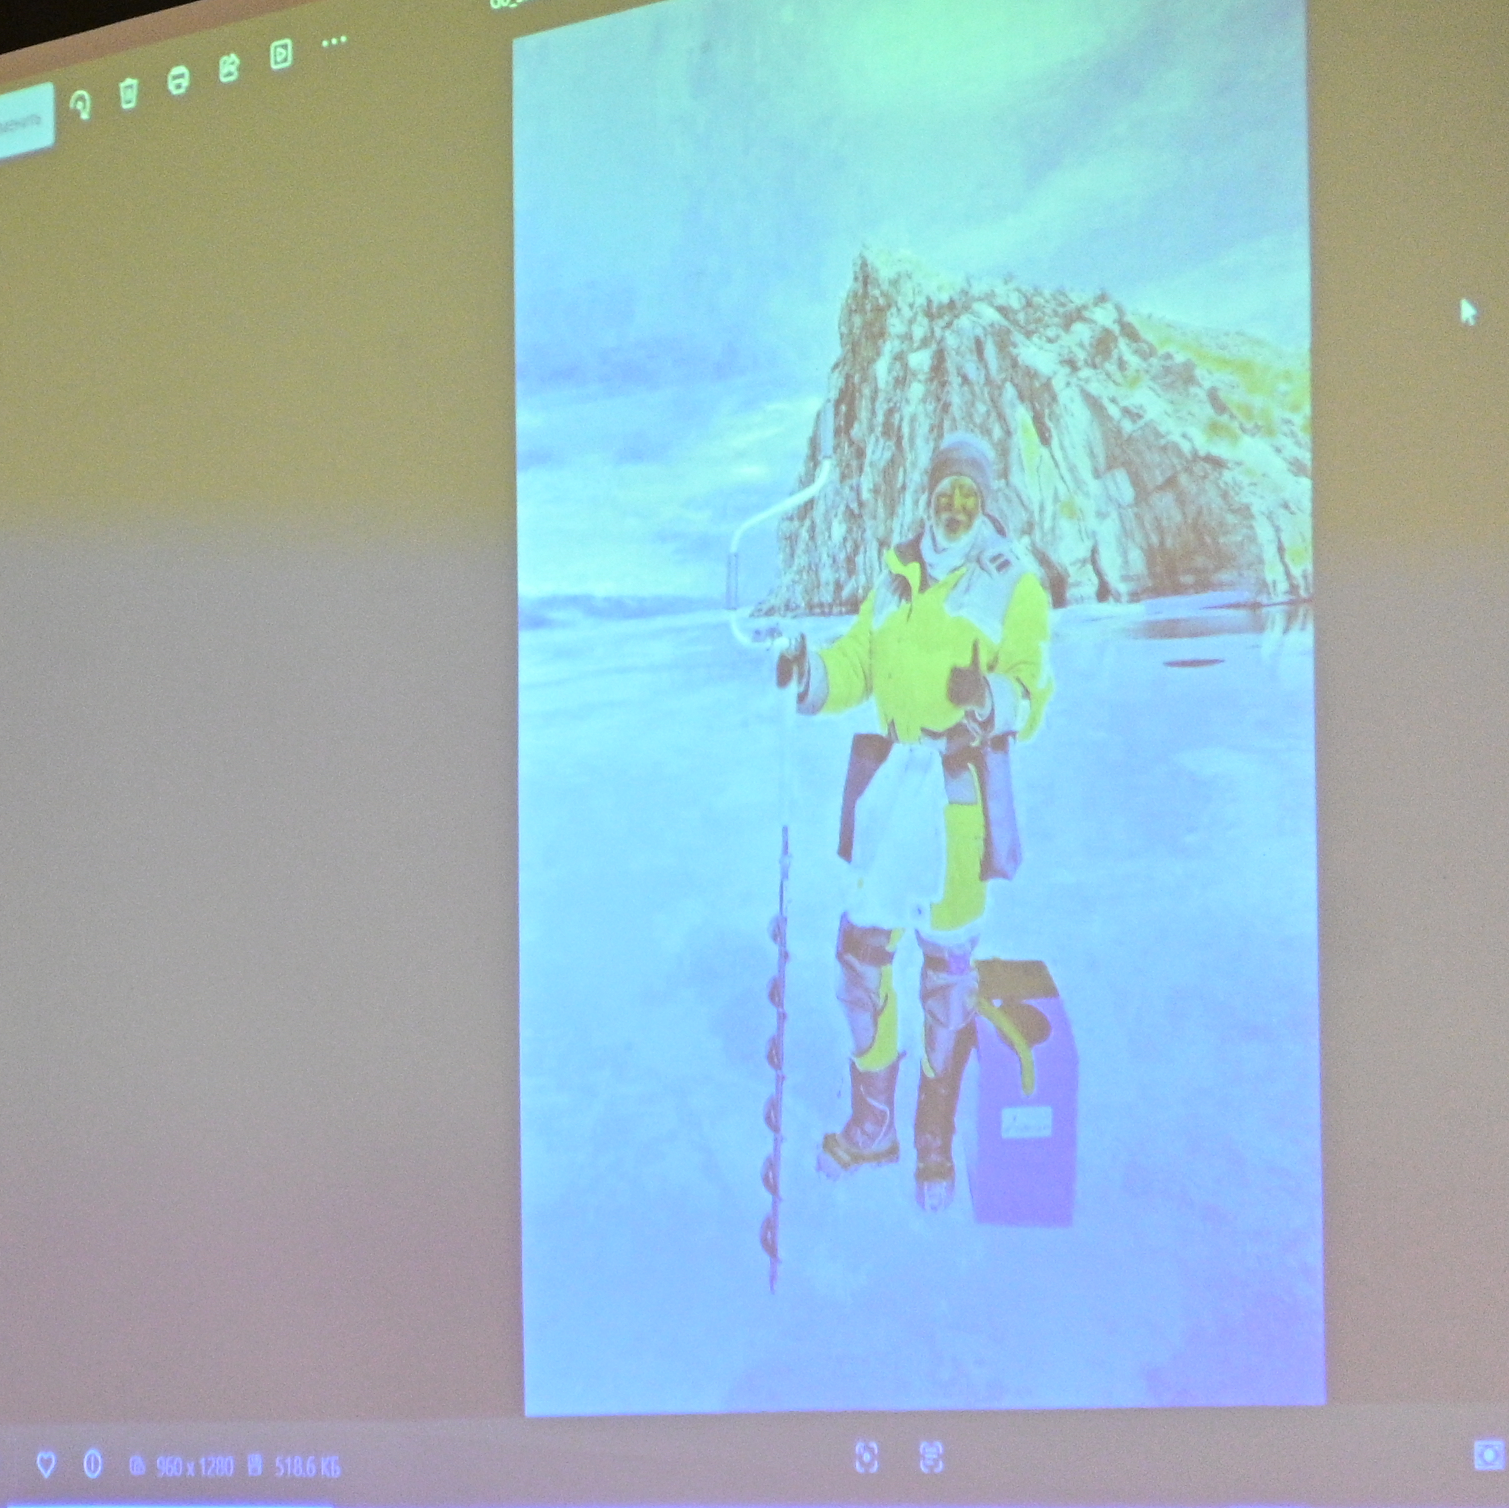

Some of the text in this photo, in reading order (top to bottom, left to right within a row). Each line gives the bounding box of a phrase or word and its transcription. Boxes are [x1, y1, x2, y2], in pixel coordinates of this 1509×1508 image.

[156, 1455, 183, 1477] 960
[199, 1455, 234, 1477] 1280
[275, 1455, 317, 1478] 518.6
